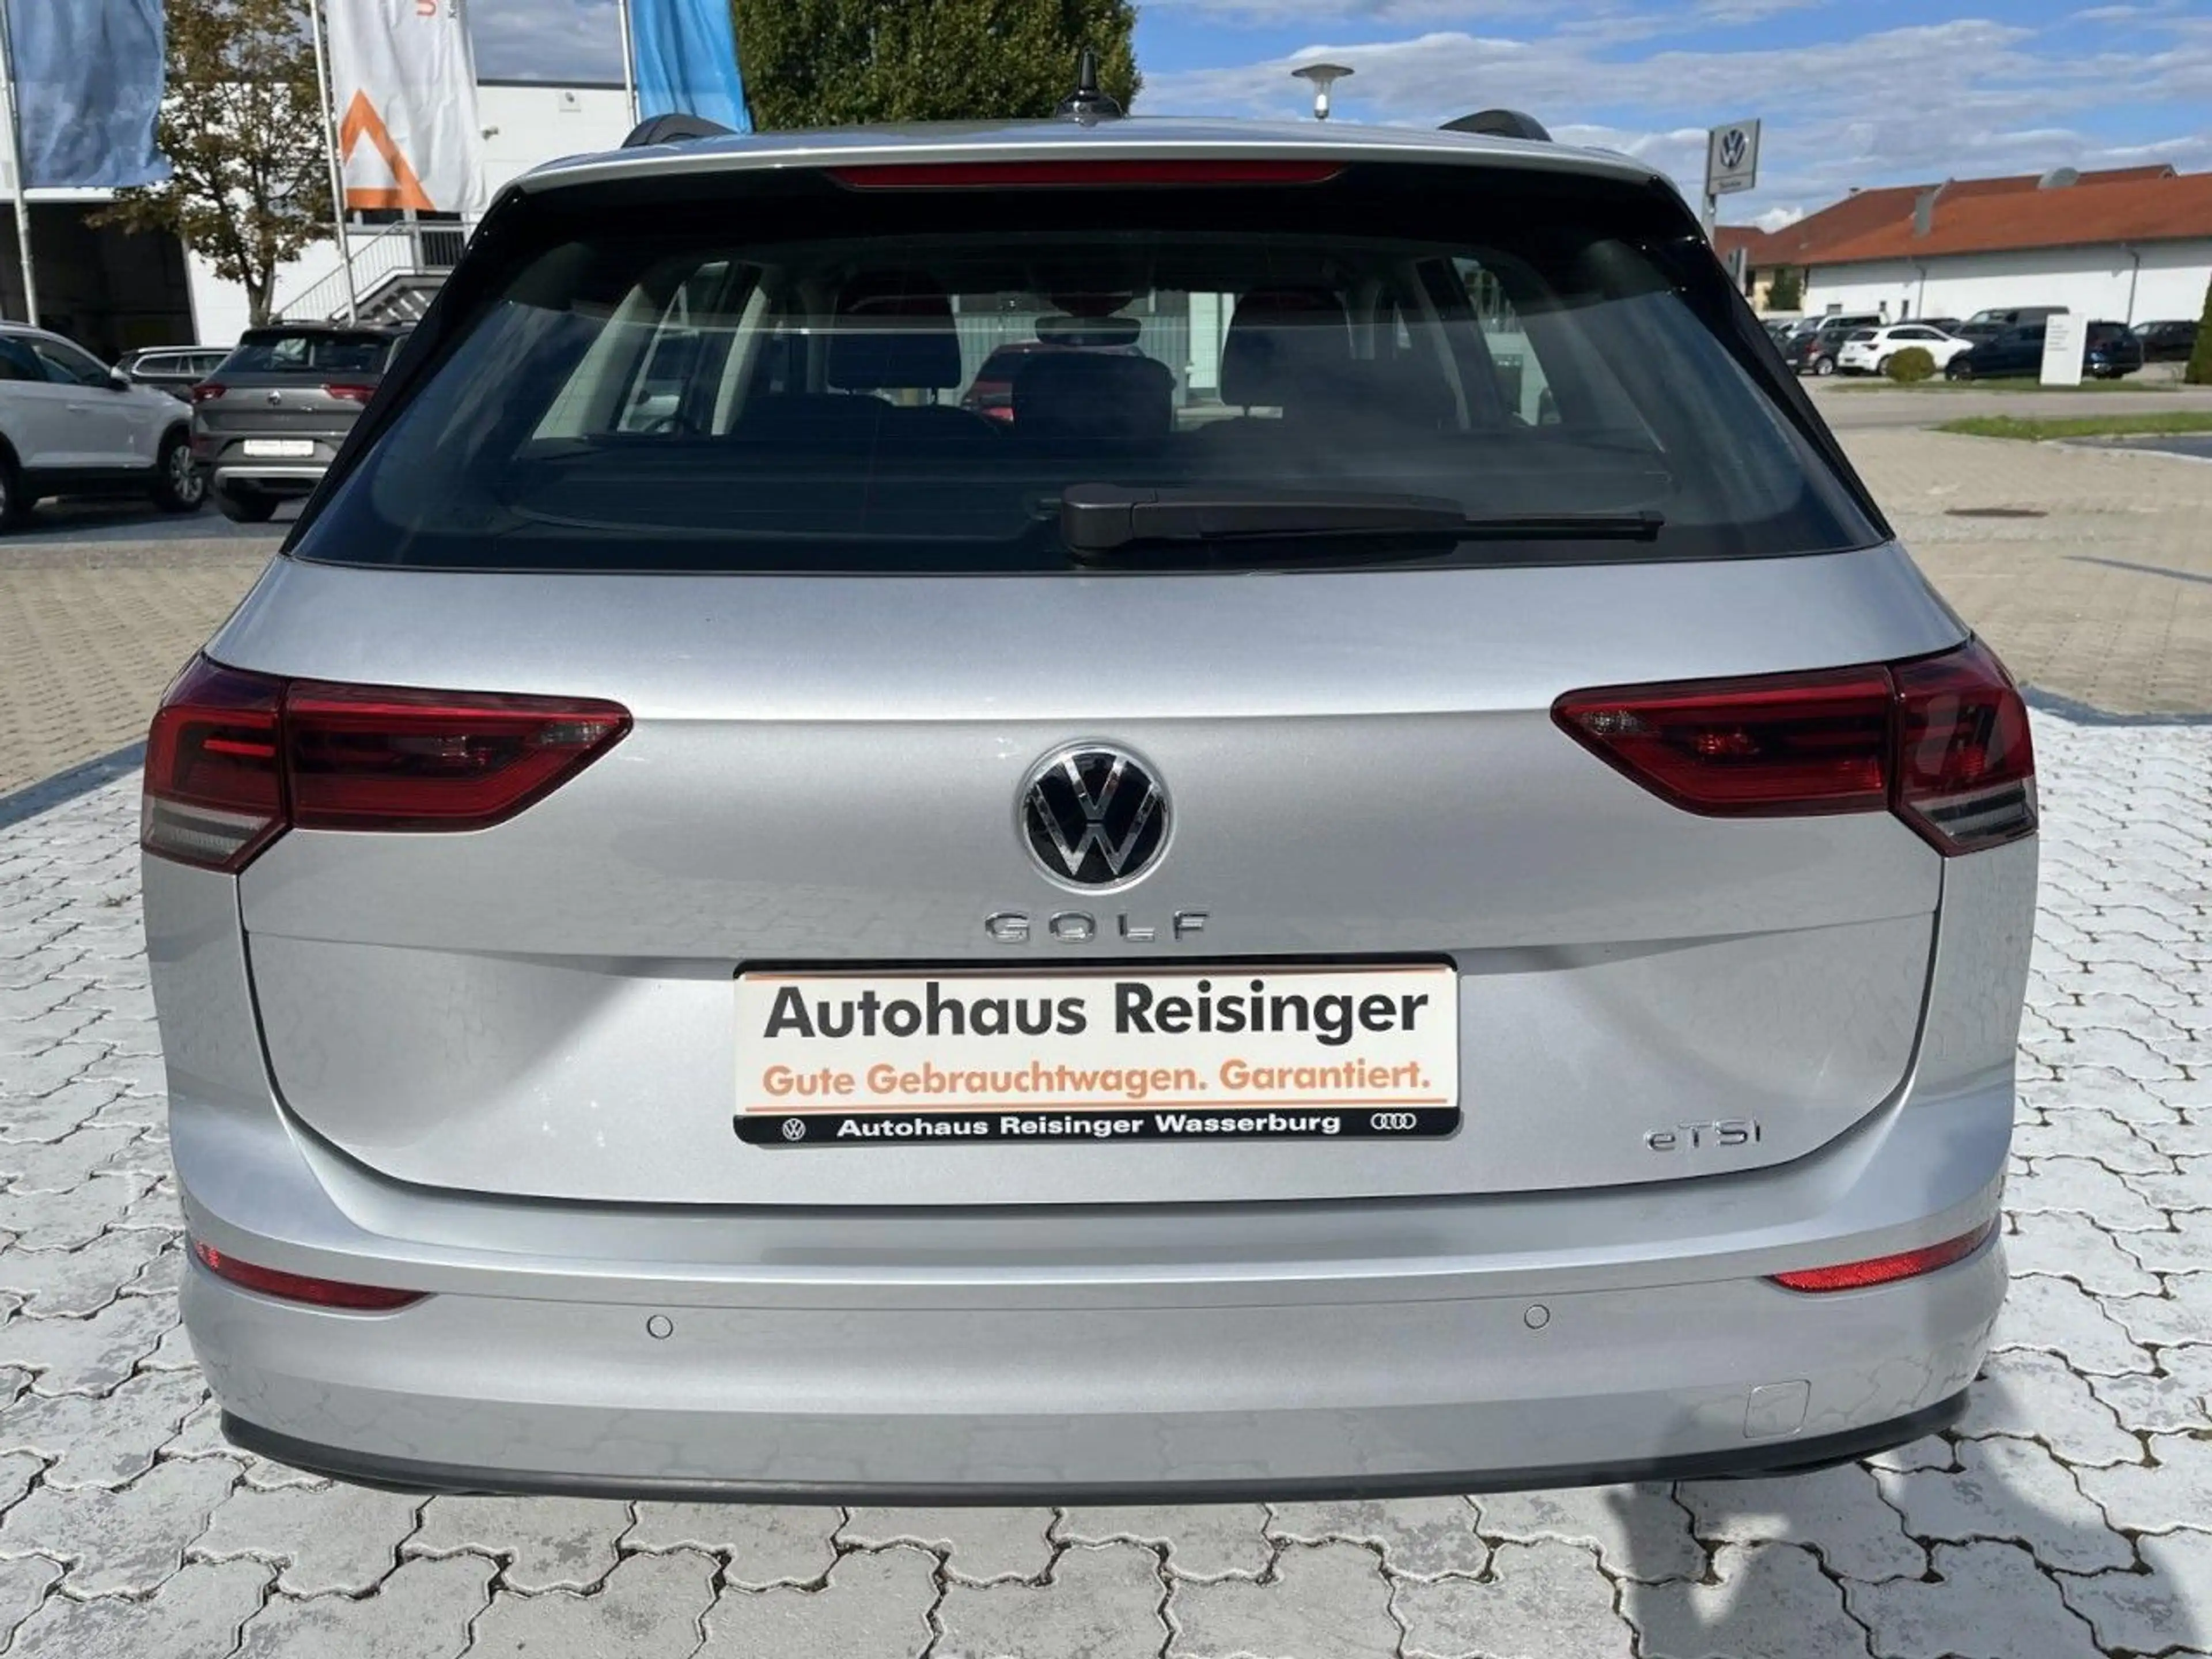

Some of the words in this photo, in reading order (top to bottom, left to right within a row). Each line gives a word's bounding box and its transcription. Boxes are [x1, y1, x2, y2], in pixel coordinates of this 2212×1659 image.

[985, 910, 1209, 942] GOLF
[763, 982, 1088, 1037] Autohaus
[1115, 979, 1429, 1046] Reisinger
[763, 1065, 855, 1096] Gute
[867, 1060, 1207, 1099] Gebrauchtwagen.
[1219, 1058, 1430, 1090] Garantiert.
[836, 1118, 989, 1137] Autohaus
[1000, 1116, 1144, 1138] Reisinger
[1155, 1114, 1341, 1133] Wasserburg
[1644, 1118, 1760, 1150] eTSI
